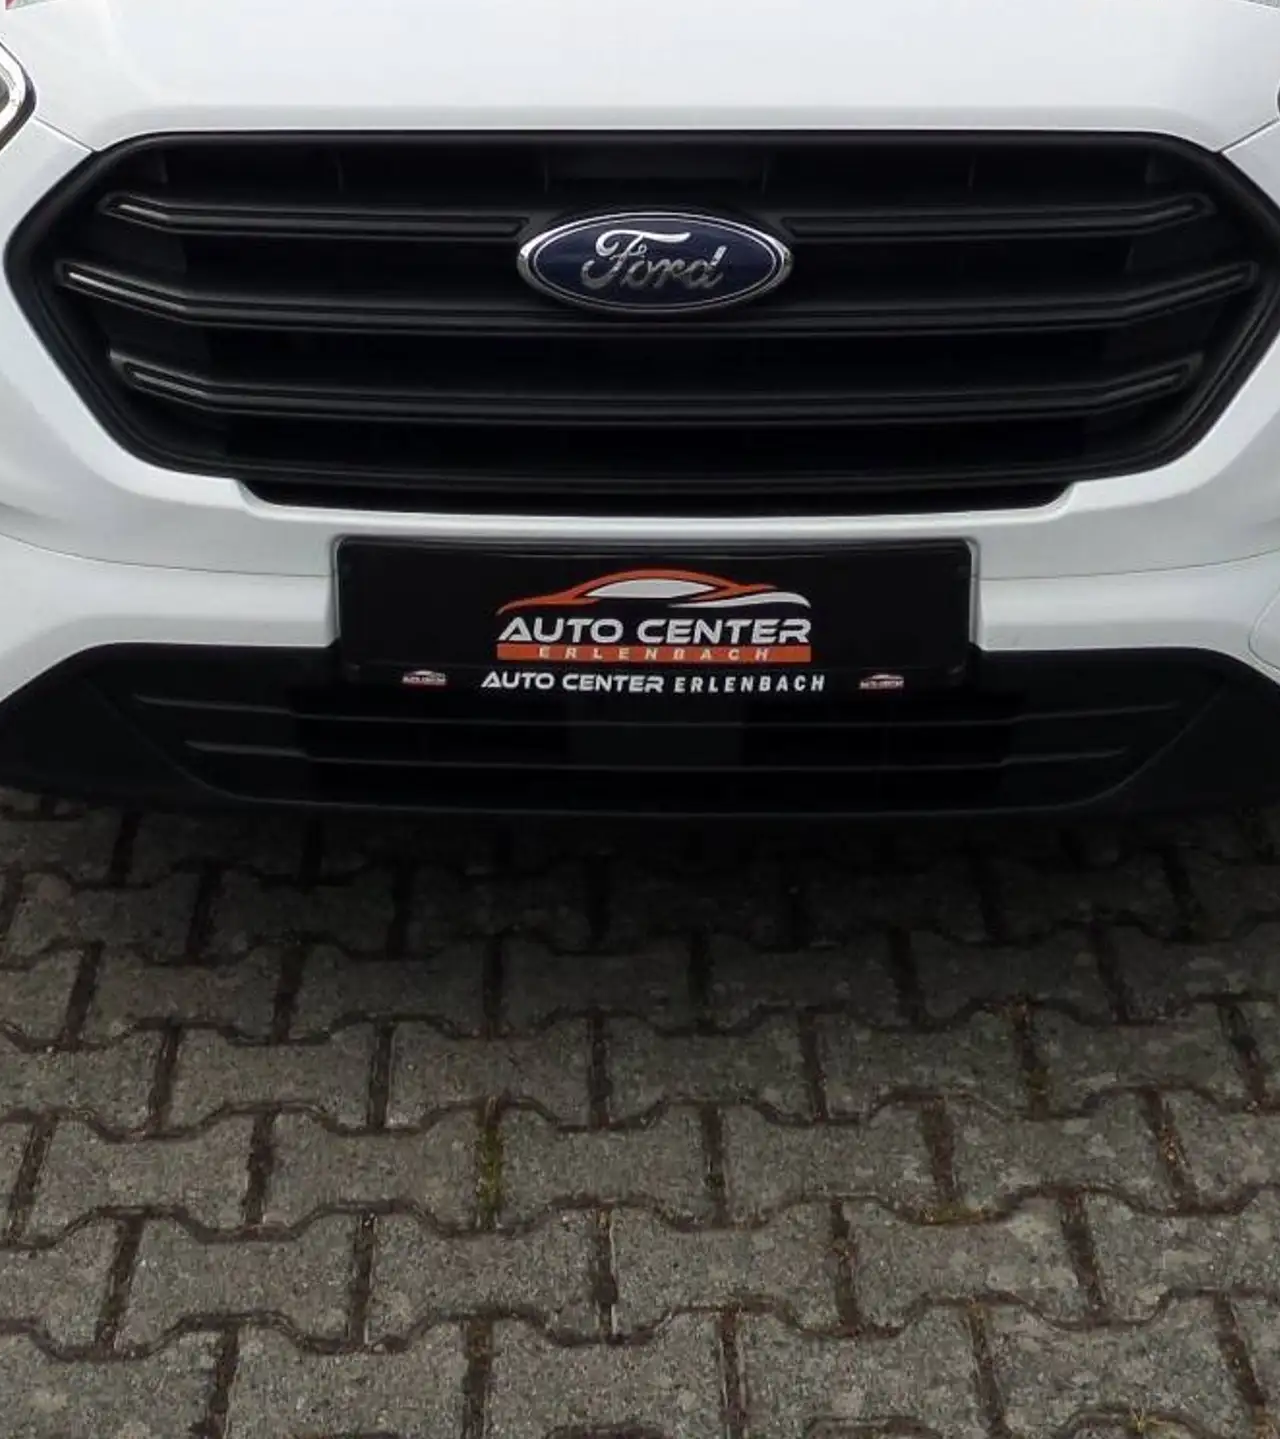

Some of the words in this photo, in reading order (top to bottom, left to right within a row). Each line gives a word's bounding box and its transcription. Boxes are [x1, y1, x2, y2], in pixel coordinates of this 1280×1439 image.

[581, 228, 727, 290] Ford
[496, 616, 624, 644] AUTO
[636, 618, 812, 645] CENTER
[538, 647, 771, 661] ERLENBACH
[480, 671, 555, 690] AUTO
[562, 674, 665, 693] CENTER
[673, 674, 826, 693] ERLENBACH
